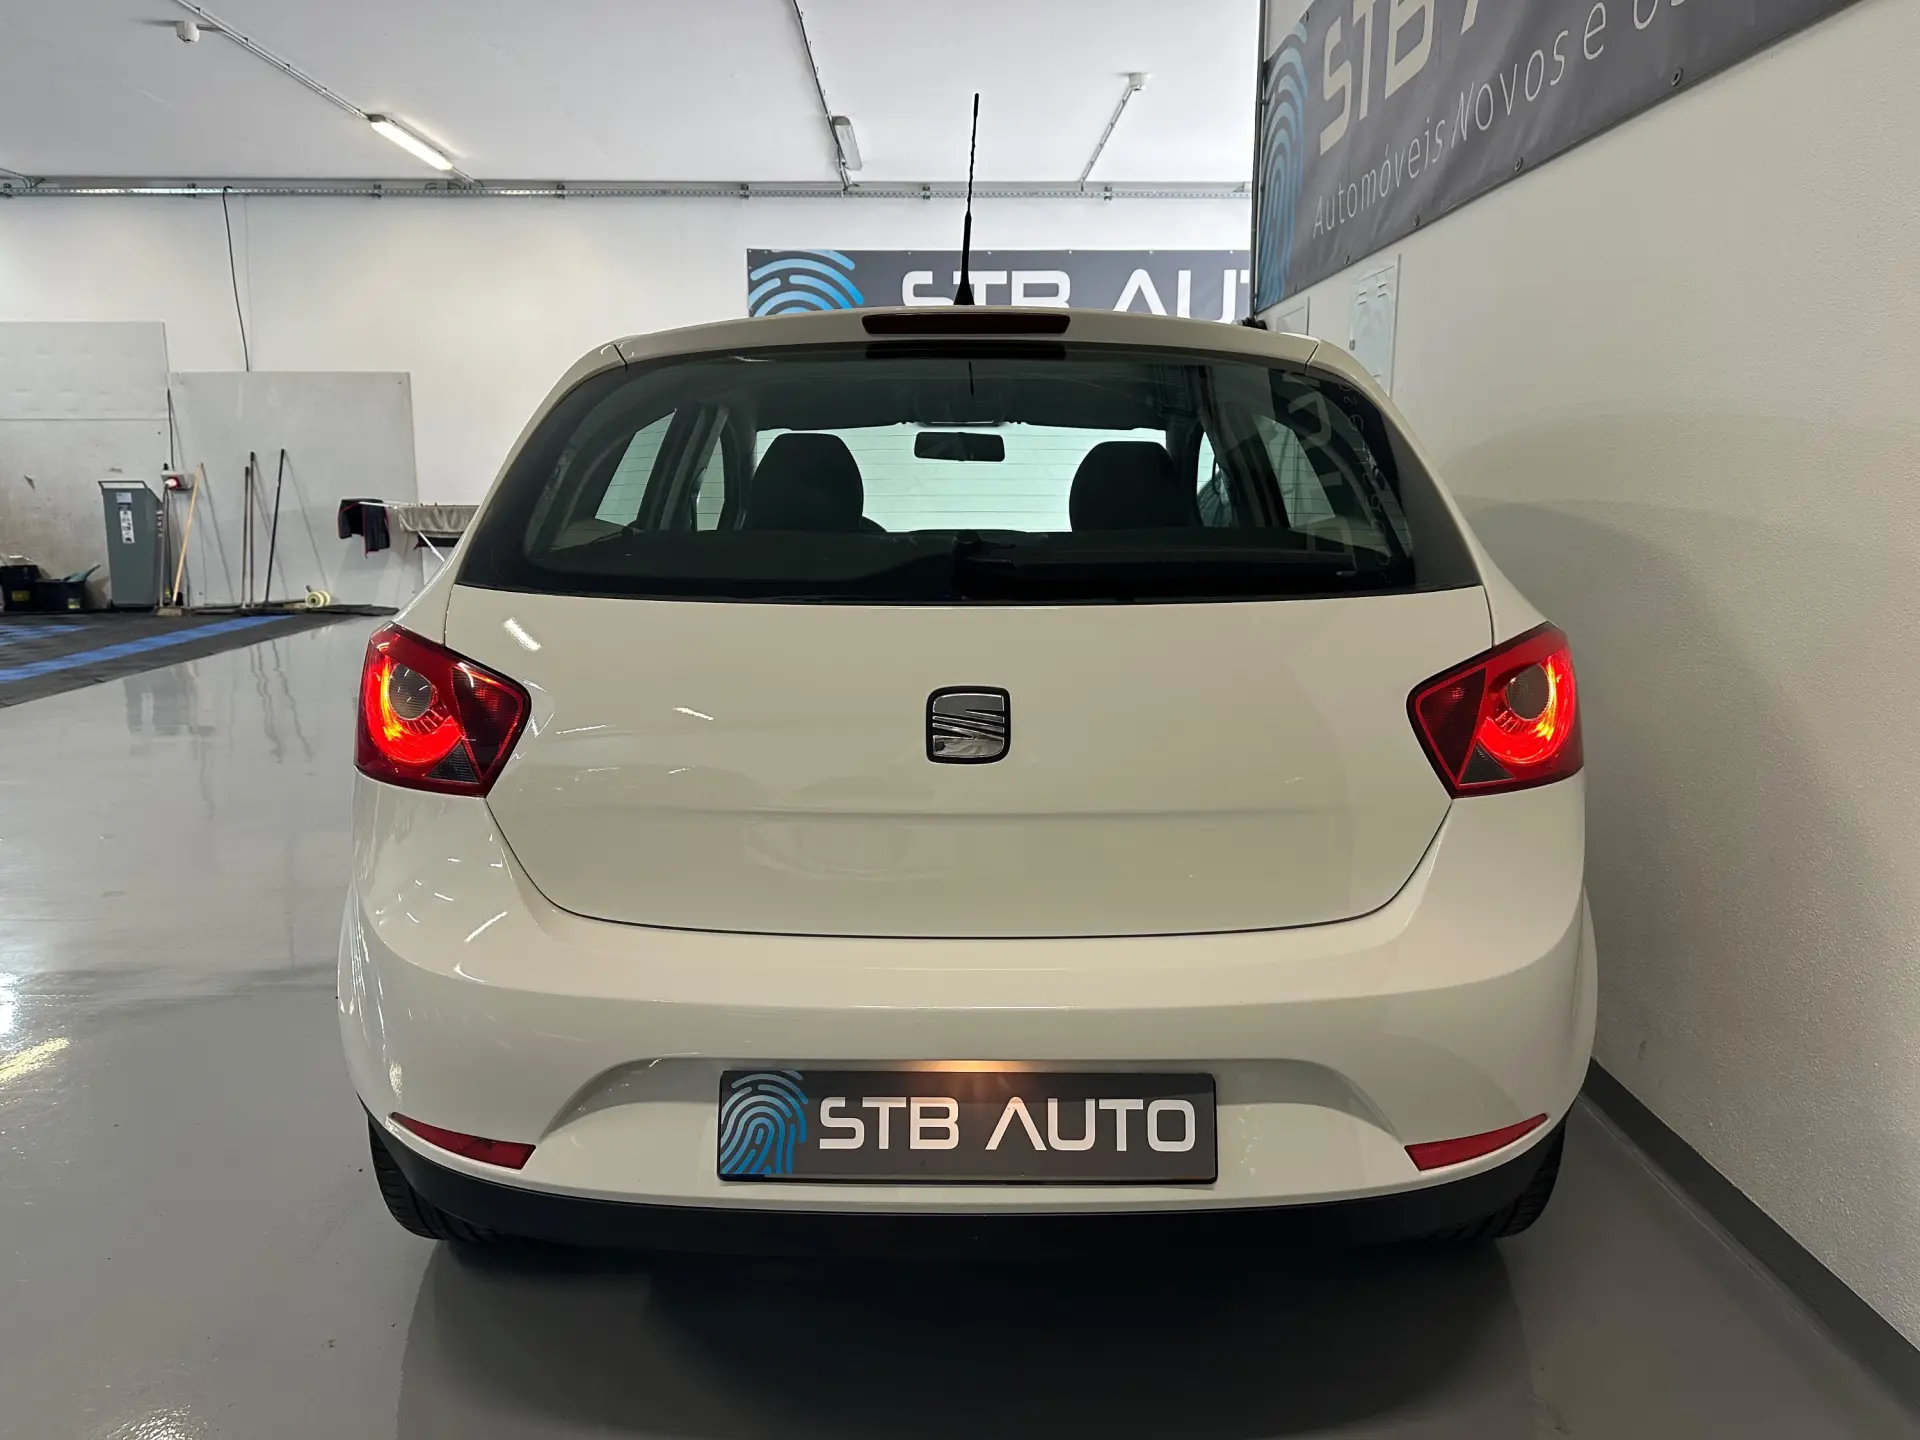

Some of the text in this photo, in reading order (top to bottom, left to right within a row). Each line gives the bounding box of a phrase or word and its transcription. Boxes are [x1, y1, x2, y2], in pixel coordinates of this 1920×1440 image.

[1313, 2, 1607, 239] Automóveis Novos e
[1320, 0, 1435, 156] STB
[902, 268, 1250, 324] STB AU
[819, 1096, 1196, 1152] STB AUTO
